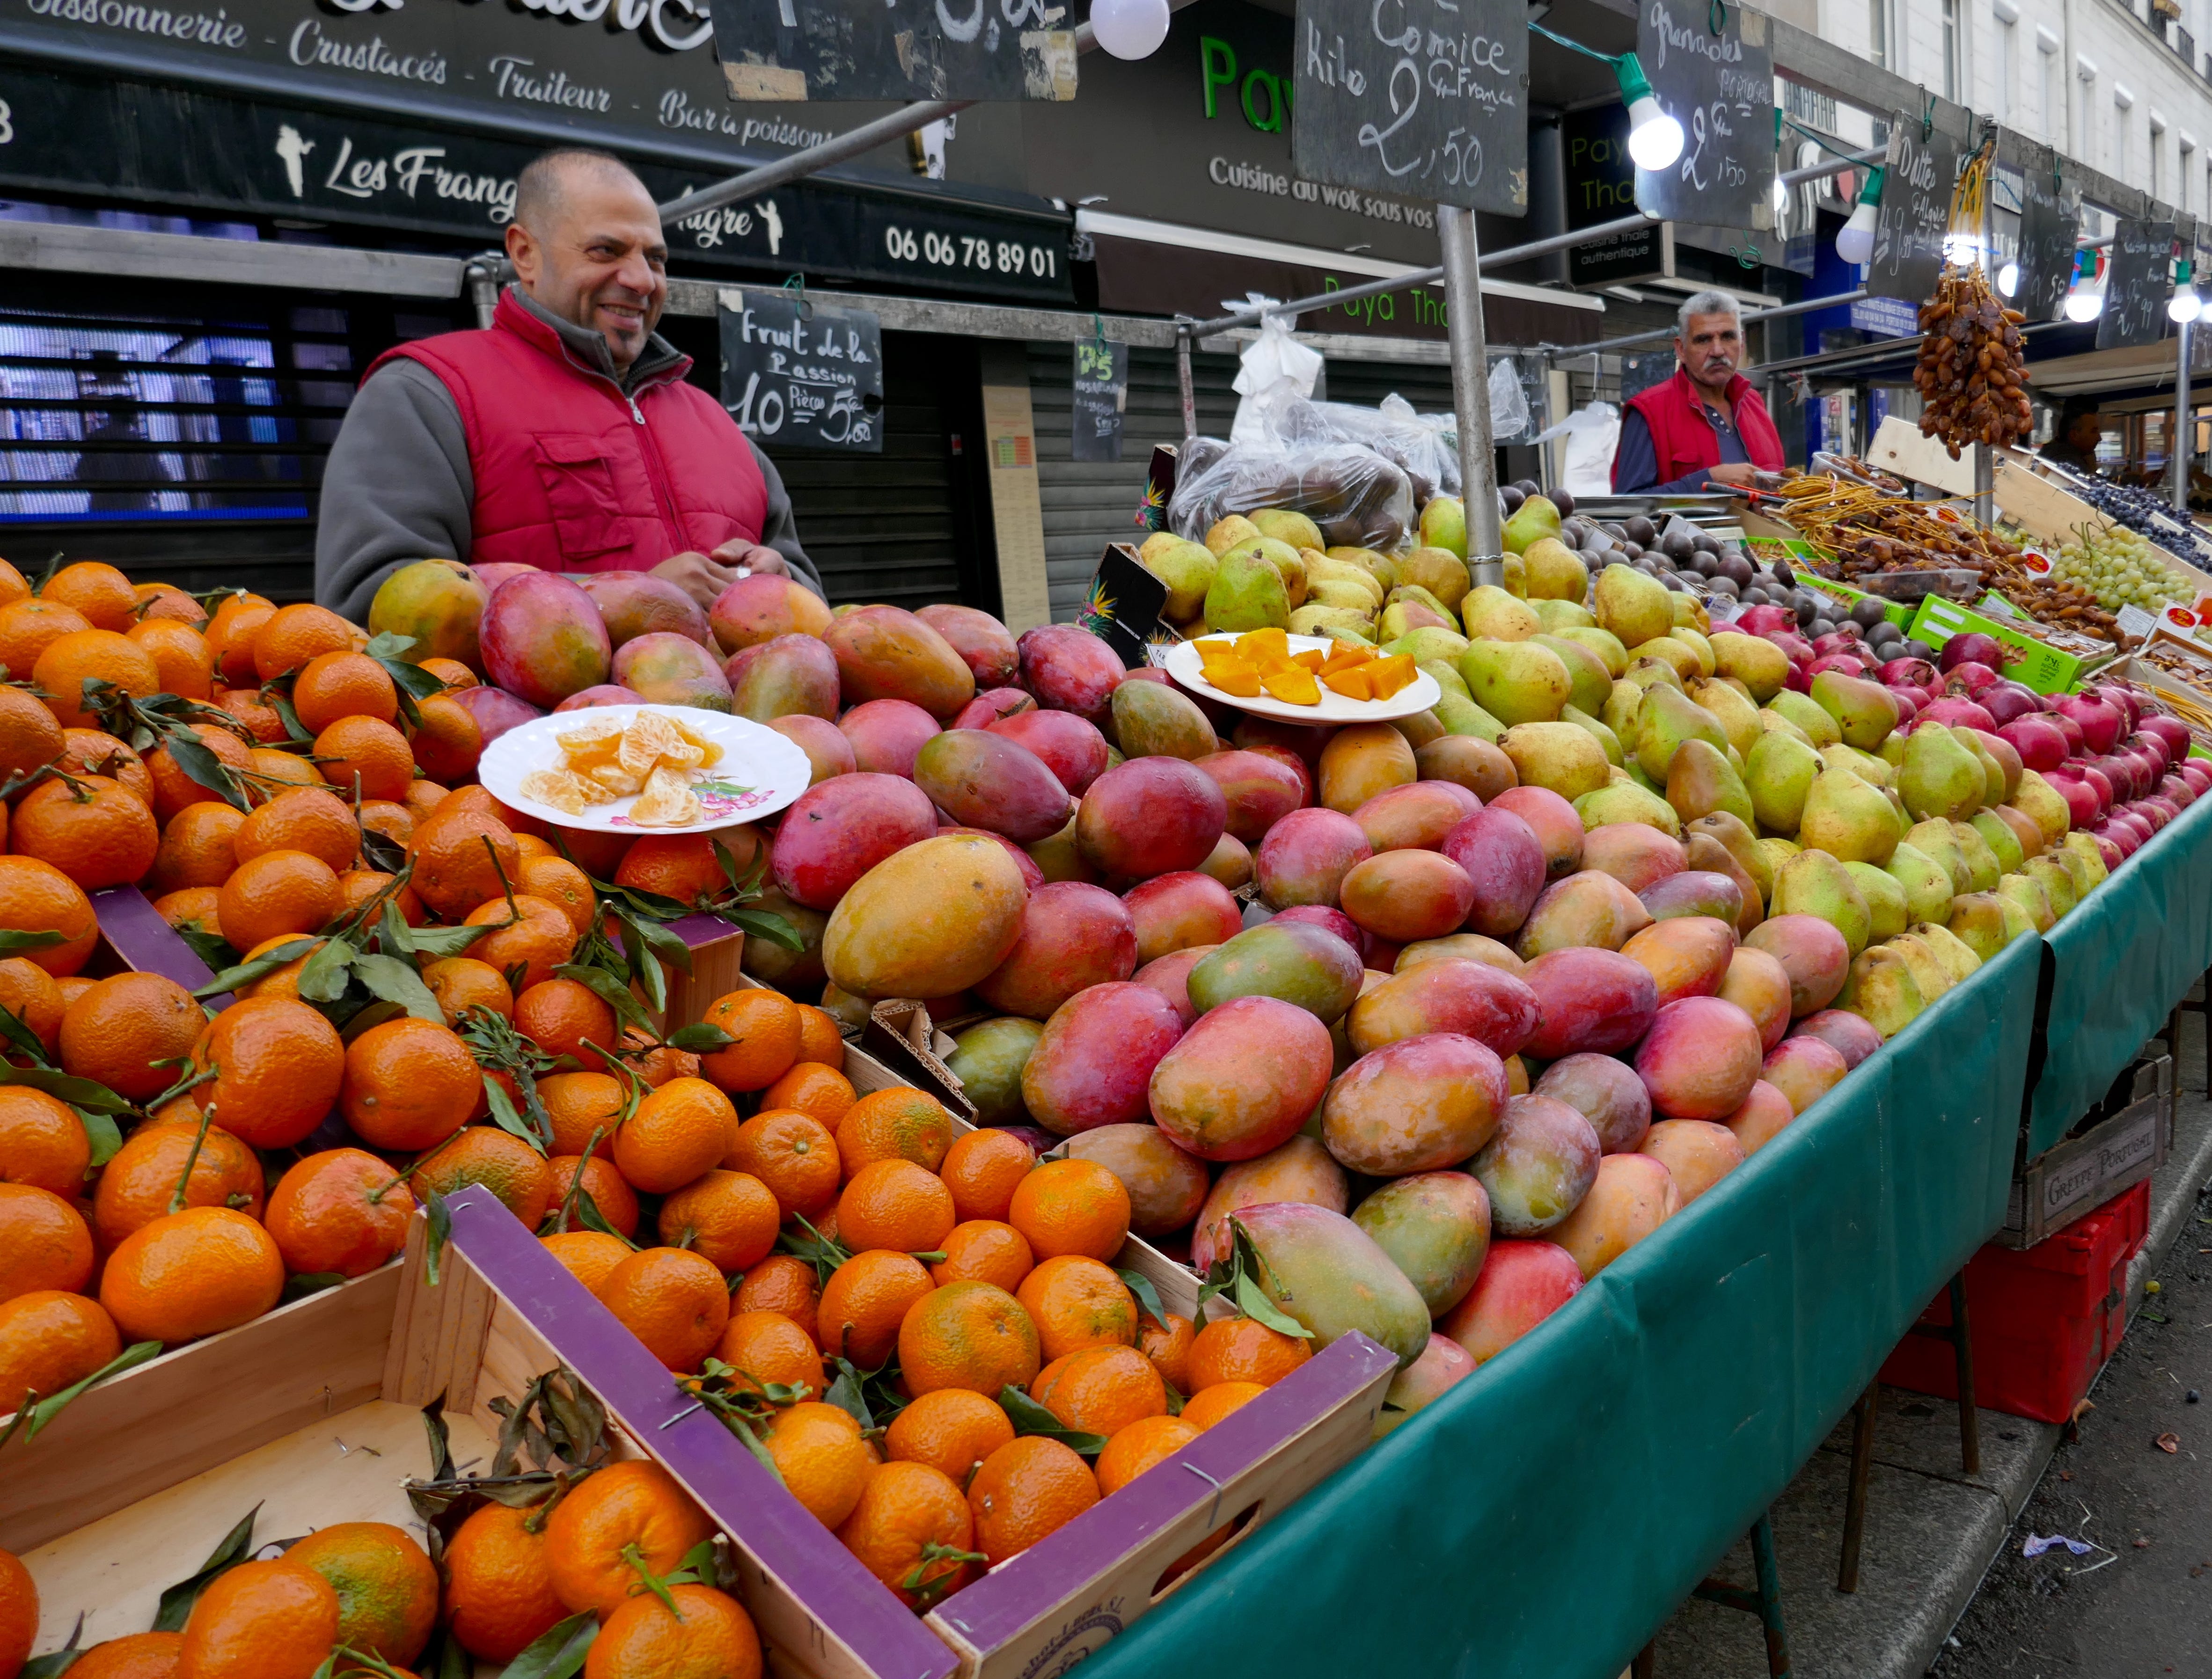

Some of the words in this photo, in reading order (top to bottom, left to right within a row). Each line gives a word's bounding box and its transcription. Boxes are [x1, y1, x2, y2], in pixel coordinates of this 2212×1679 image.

[27, 0, 248, 48] oissonnerie
[289, 19, 446, 85] Crustacés
[490, 56, 611, 113] Traiteur
[659, 89, 707, 131] Bar
[721, 107, 740, 136] à
[1200, 36, 1293, 134] Pa
[325, 136, 388, 198] Les
[394, 147, 518, 224] Frang
[1572, 137, 1627, 167] Pay
[1209, 157, 1288, 196] Cuisine
[1292, 180, 1318, 202] au
[1321, 185, 1361, 212] wok
[1363, 197, 1401, 222] sous
[1404, 209, 1434, 229] vos
[886, 226, 918, 261] 06
[924, 231, 956, 266] 06
[961, 236, 991, 270] 78
[997, 241, 1025, 274] 89
[1030, 246, 1055, 278] 01
[1581, 244, 1649, 265] authentique
[766, 352, 857, 386] Passion
[817, 328, 843, 358] de
[847, 330, 872, 364] la
[727, 372, 784, 435] 10
